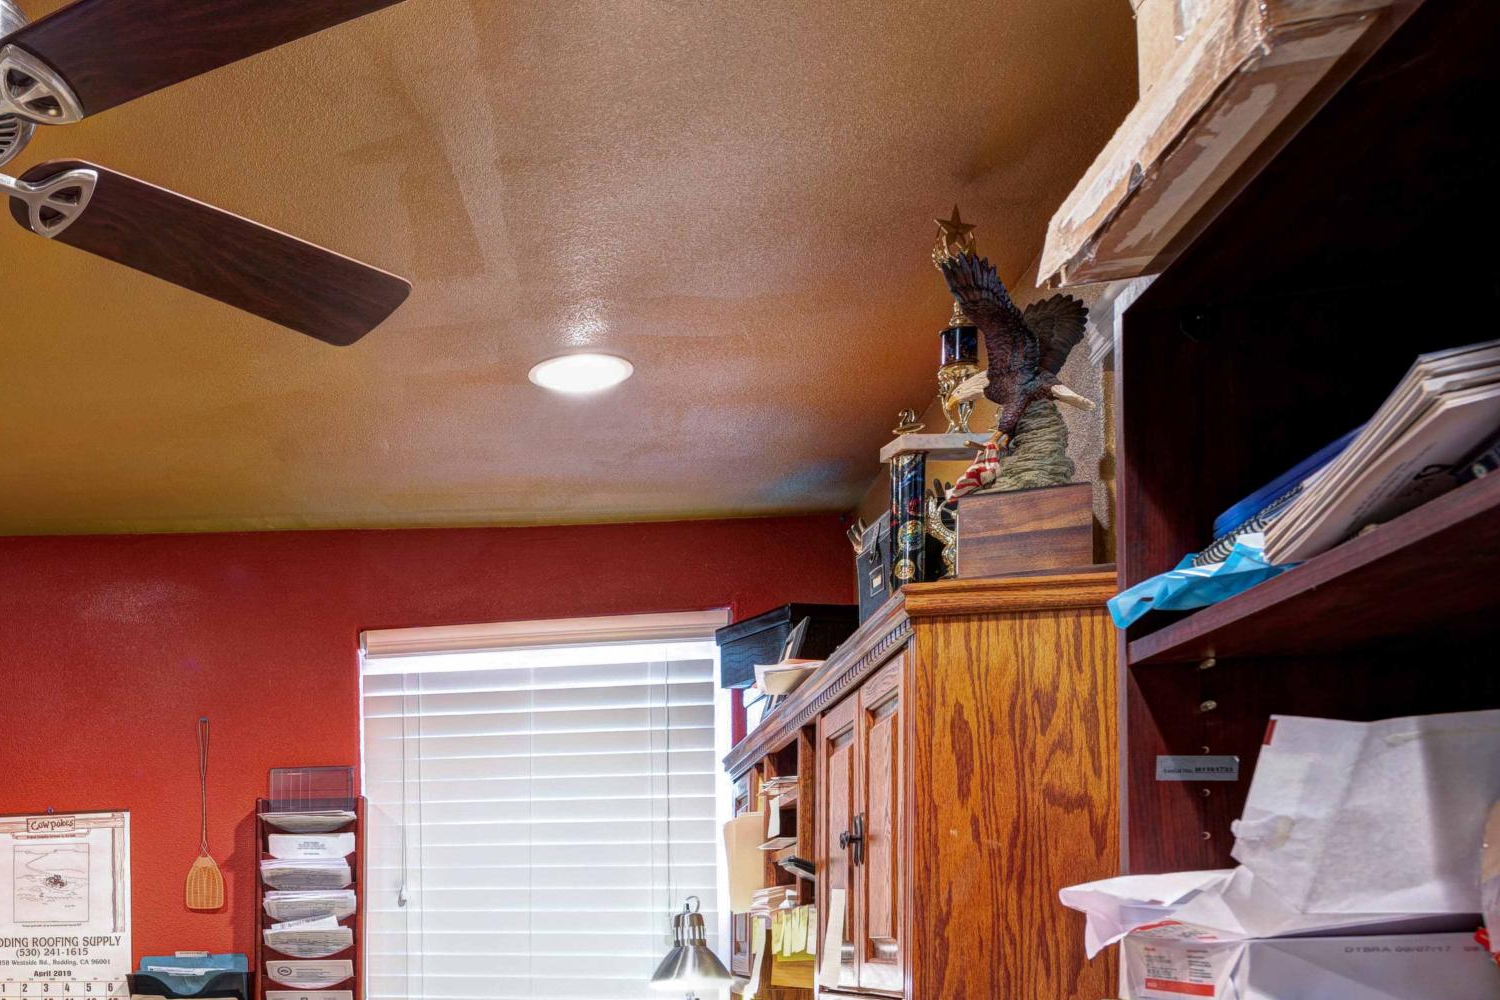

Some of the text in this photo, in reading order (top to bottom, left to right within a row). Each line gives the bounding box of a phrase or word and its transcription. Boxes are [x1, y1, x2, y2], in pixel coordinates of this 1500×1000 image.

[32, 937, 79, 947] ROOFING
[83, 936, 121, 947] SUPPLY
[16, 948, 88, 958] (530) 241-1615
[2, 983, 113, 992] 1 2 3 4 5 6
